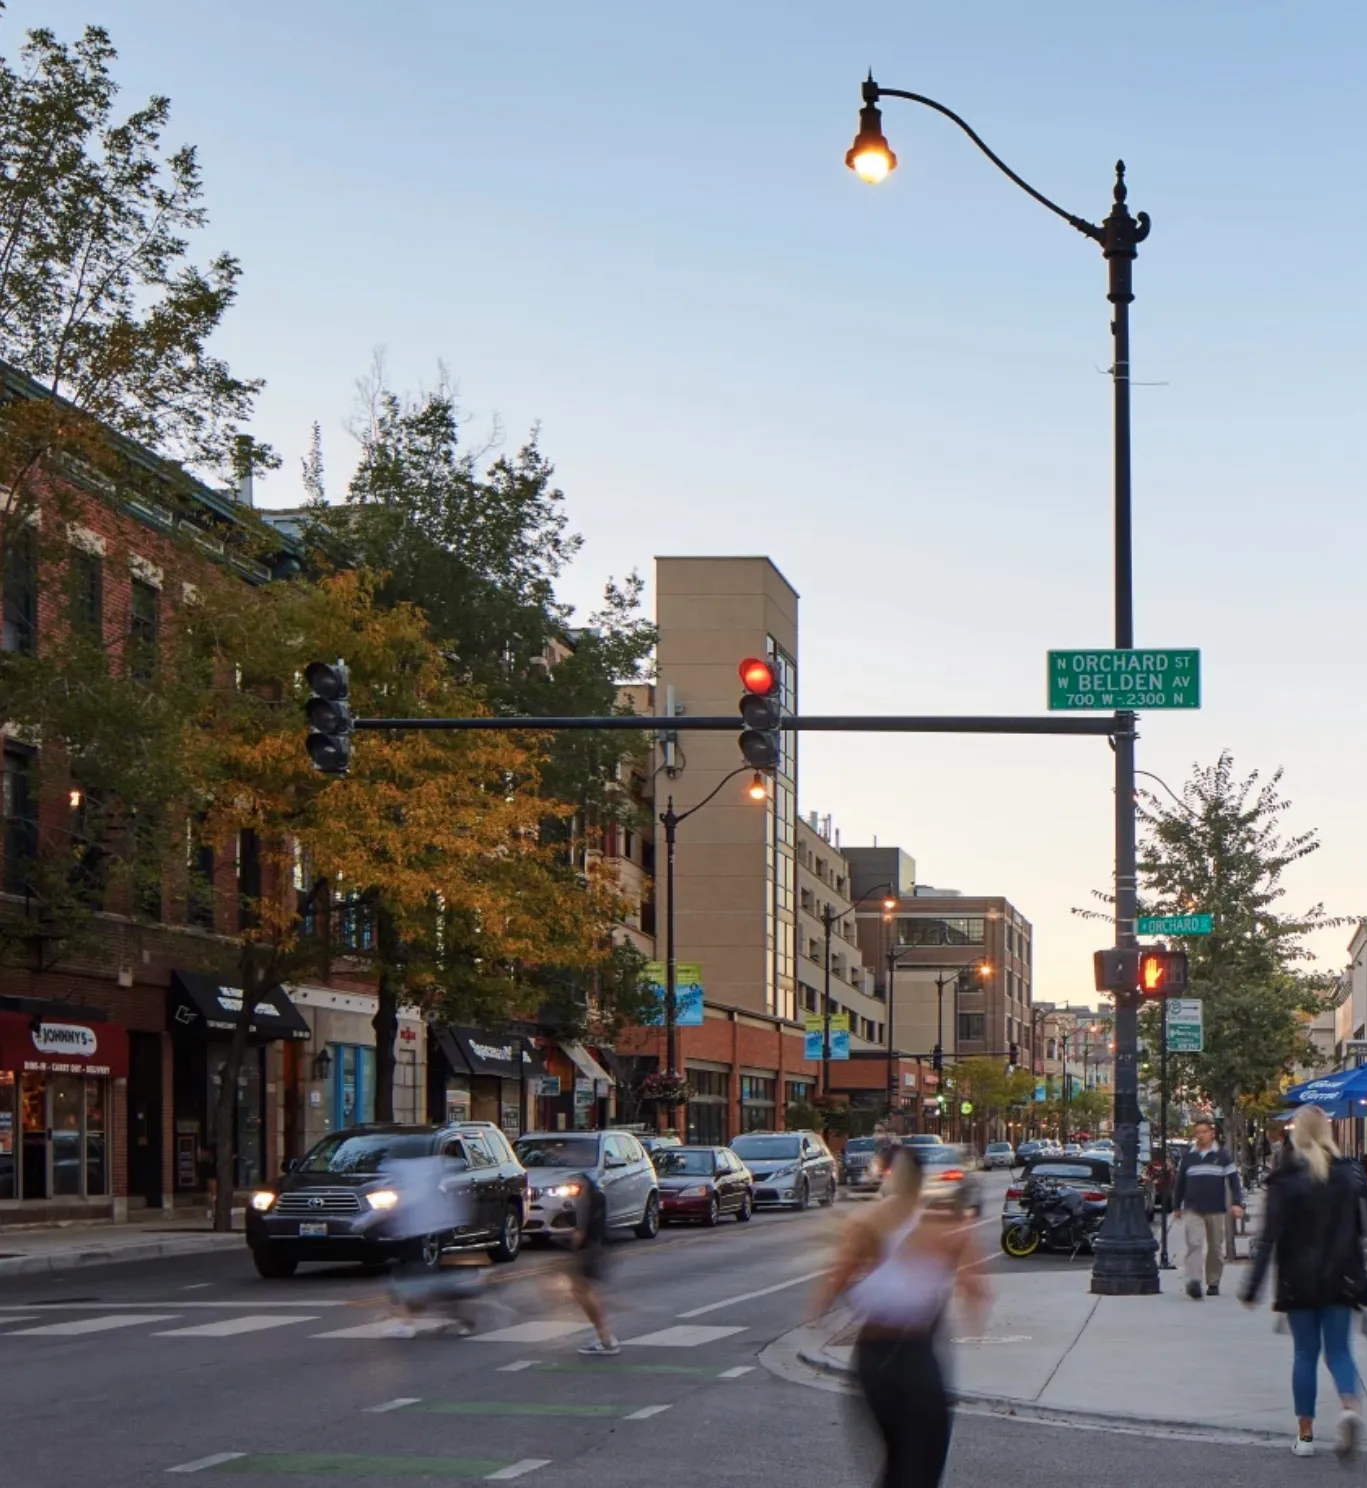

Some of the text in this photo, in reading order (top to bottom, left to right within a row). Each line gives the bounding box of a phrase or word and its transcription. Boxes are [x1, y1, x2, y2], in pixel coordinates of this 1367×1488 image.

[1057, 654, 1191, 672] N ORCHARD ST
[1058, 673, 1191, 691] W BELDEN AV
[1066, 693, 1095, 706] 700
[1102, 693, 1113, 706] W
[1126, 692, 1166, 706] 2300
[1173, 693, 1184, 705] N
[1148, 917, 1199, 933] ORCHARD
